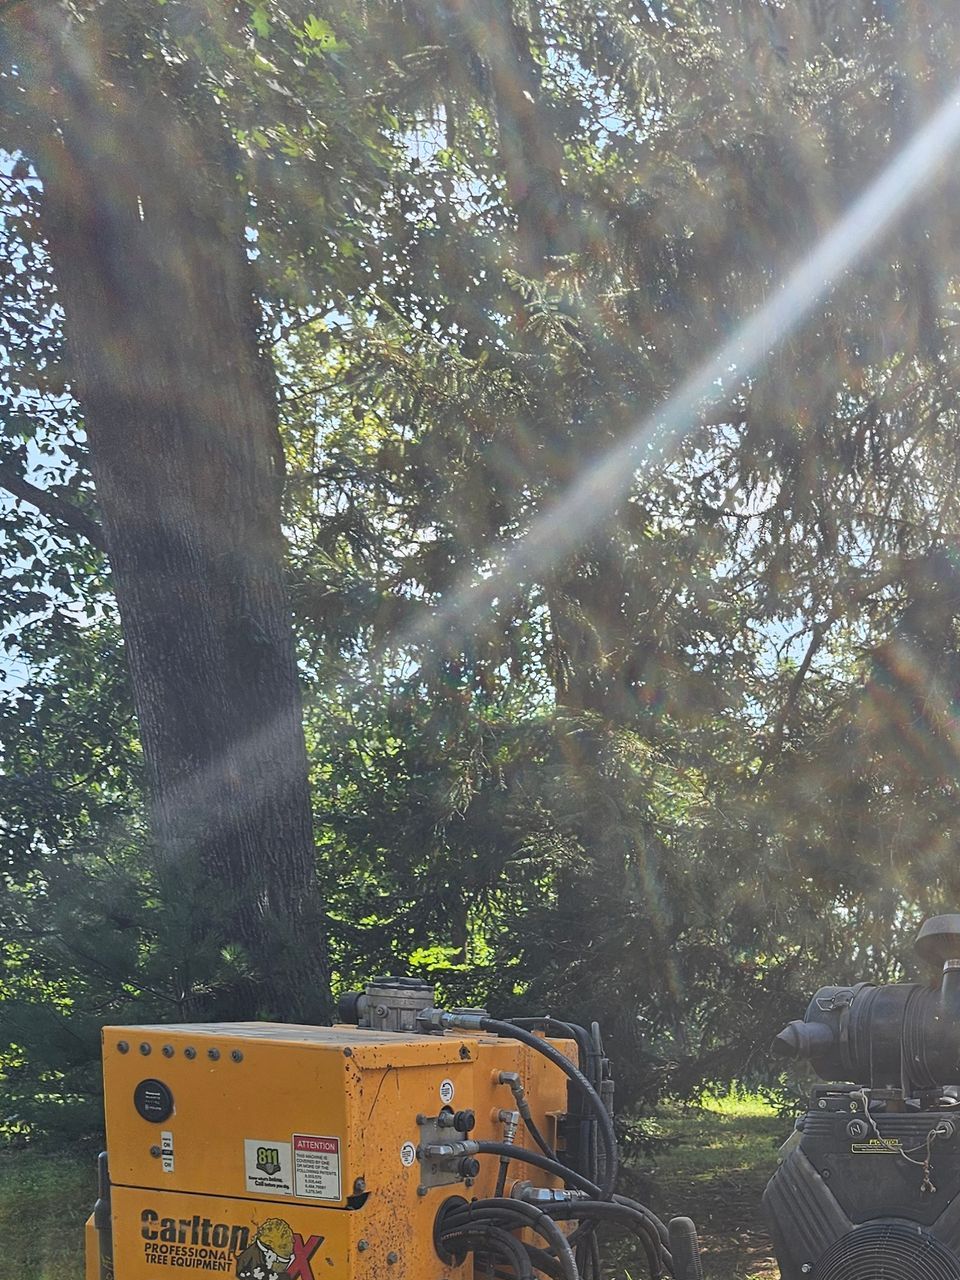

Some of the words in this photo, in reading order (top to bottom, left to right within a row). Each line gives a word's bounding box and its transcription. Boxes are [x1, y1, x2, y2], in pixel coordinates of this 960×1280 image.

[297, 1140, 336, 1151] ATTENTION
[256, 1146, 279, 1166] 811
[141, 1208, 251, 1254] Carlton
[144, 1243, 233, 1262] PROFESSIONAL
[145, 1253, 168, 1265] TREE
[171, 1255, 233, 1273] EQUIPMENT
